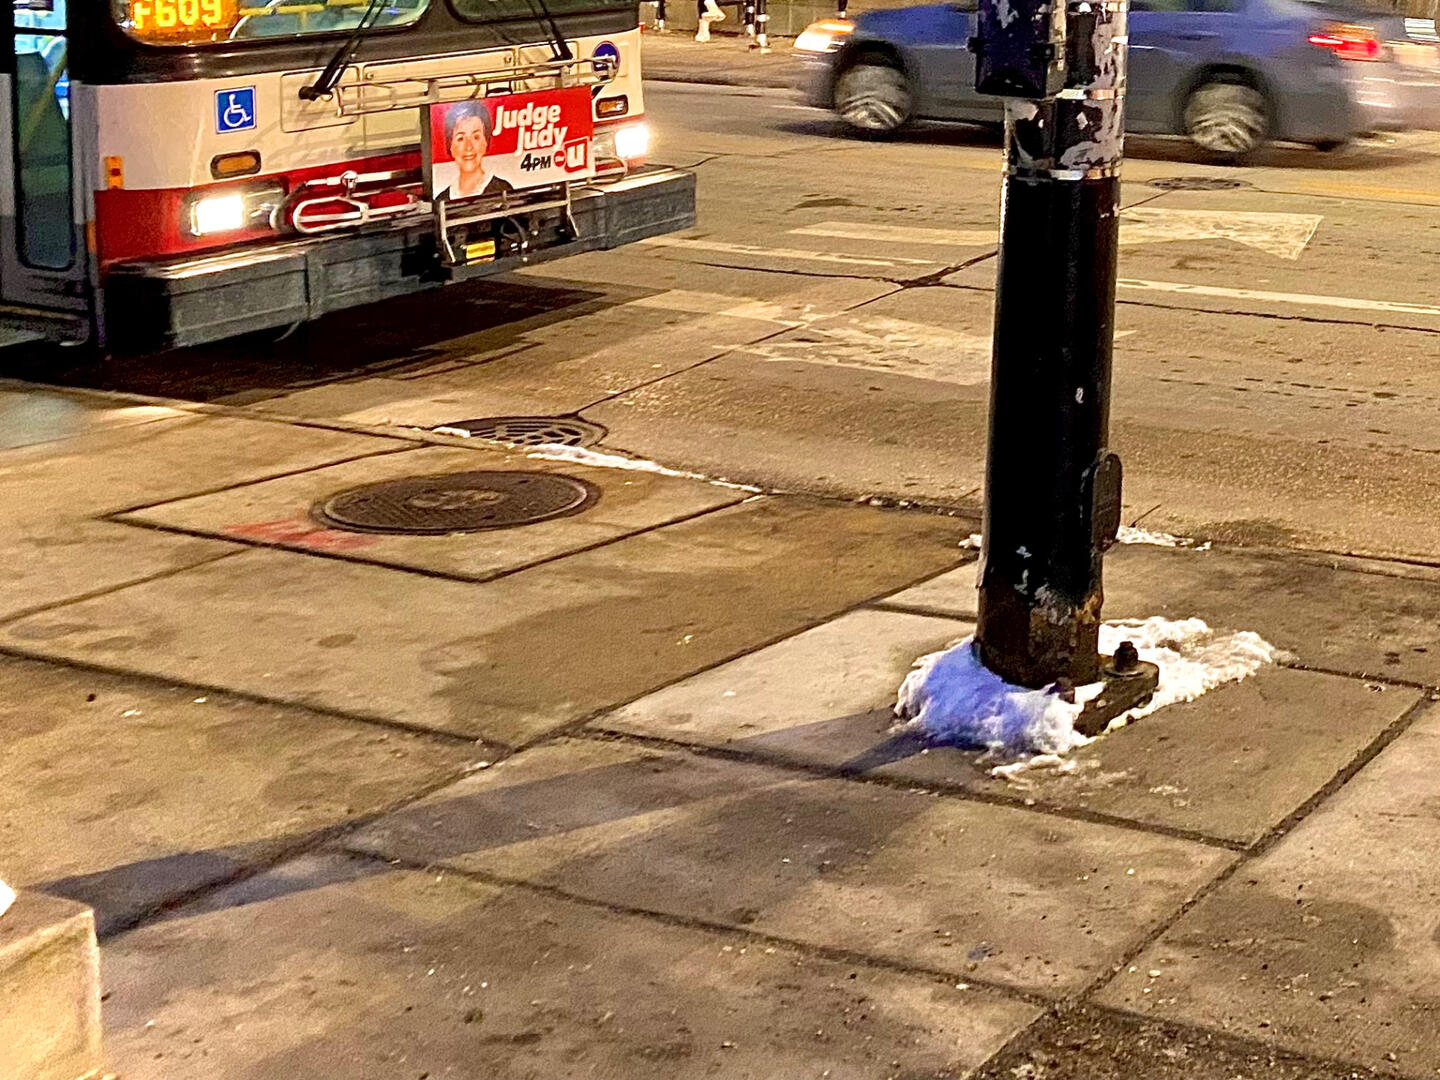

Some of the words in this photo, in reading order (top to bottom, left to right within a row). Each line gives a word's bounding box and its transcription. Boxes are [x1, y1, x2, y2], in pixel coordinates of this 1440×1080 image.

[492, 102, 561, 137] Judge
[514, 123, 568, 157] Judy
[520, 153, 551, 172] 4PM
